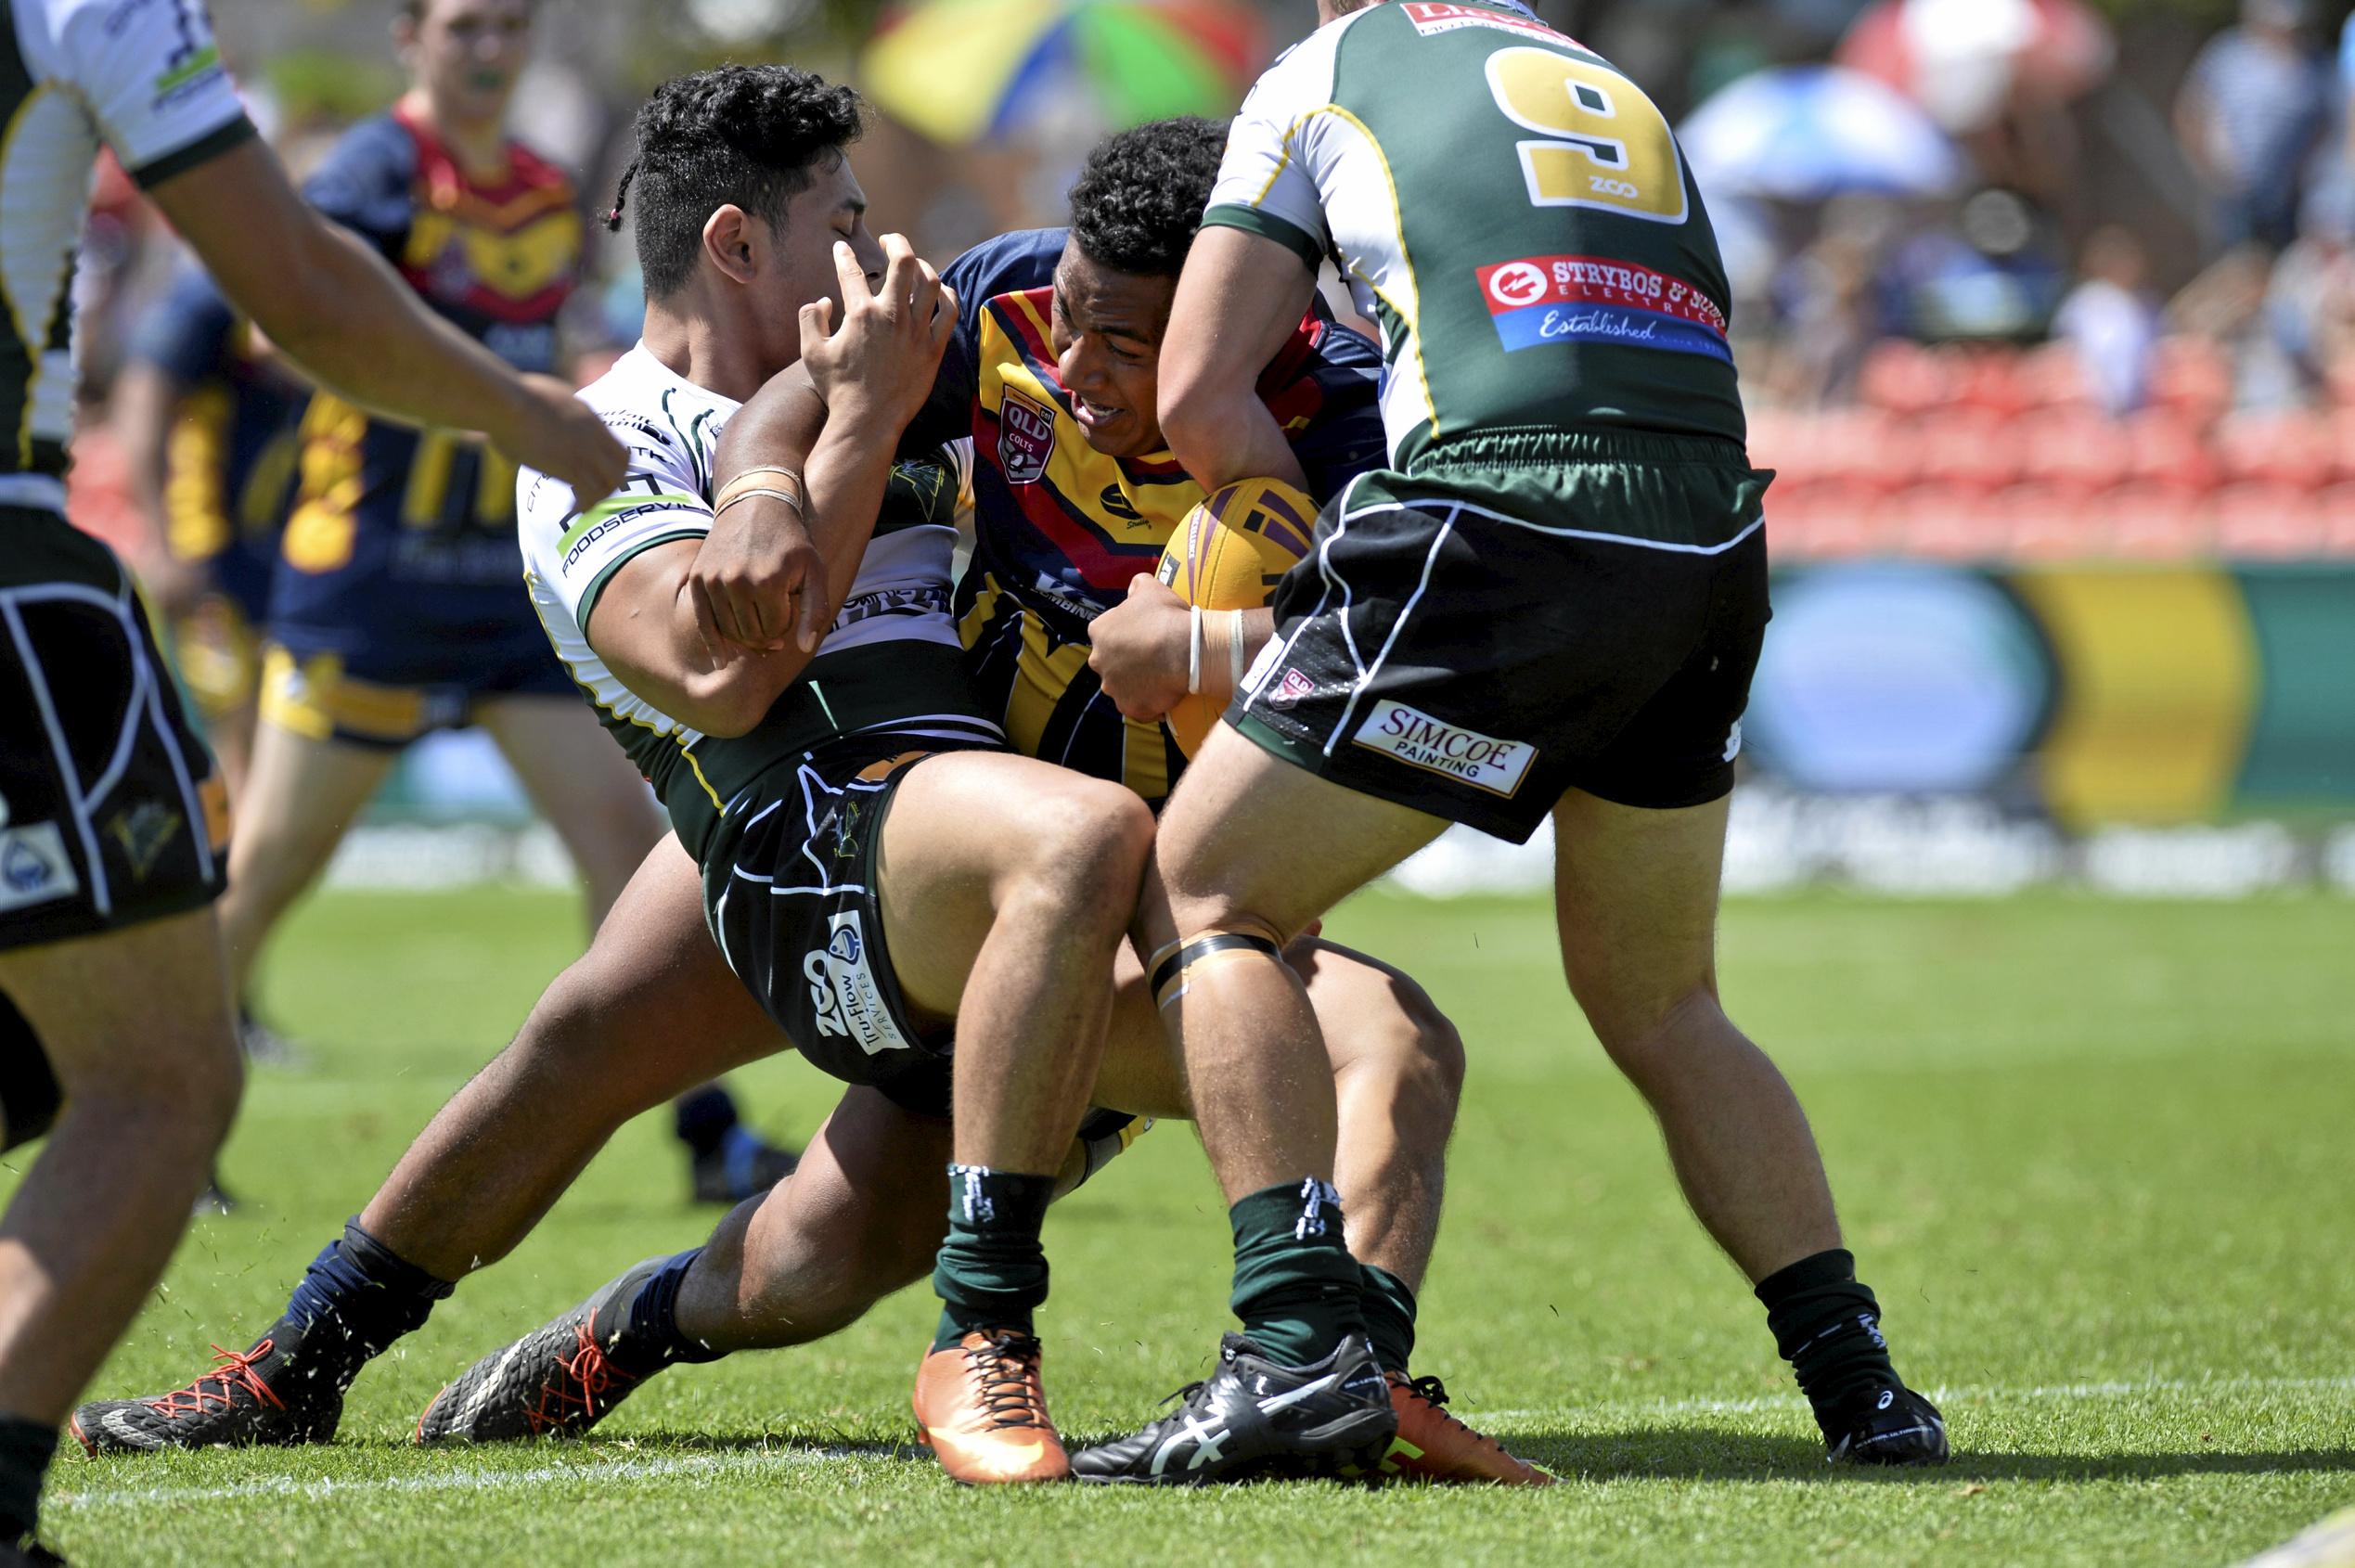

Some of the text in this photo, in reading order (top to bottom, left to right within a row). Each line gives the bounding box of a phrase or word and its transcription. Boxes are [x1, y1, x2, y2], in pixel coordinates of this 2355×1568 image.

[1486, 46, 1689, 225] 9
[1552, 261, 1663, 299] STRYBOS
[1668, 281, 1688, 302] &
[1538, 309, 1657, 340] Established
[1009, 405, 1049, 442] QLD
[1009, 432, 1034, 454] COLTS
[1287, 673, 1309, 693] QLD
[1380, 708, 1517, 771] SIMCOE
[1394, 741, 1480, 778] PAINTING
[842, 975, 880, 1047] Tru-Flow
[856, 972, 896, 1040] SERVICES
